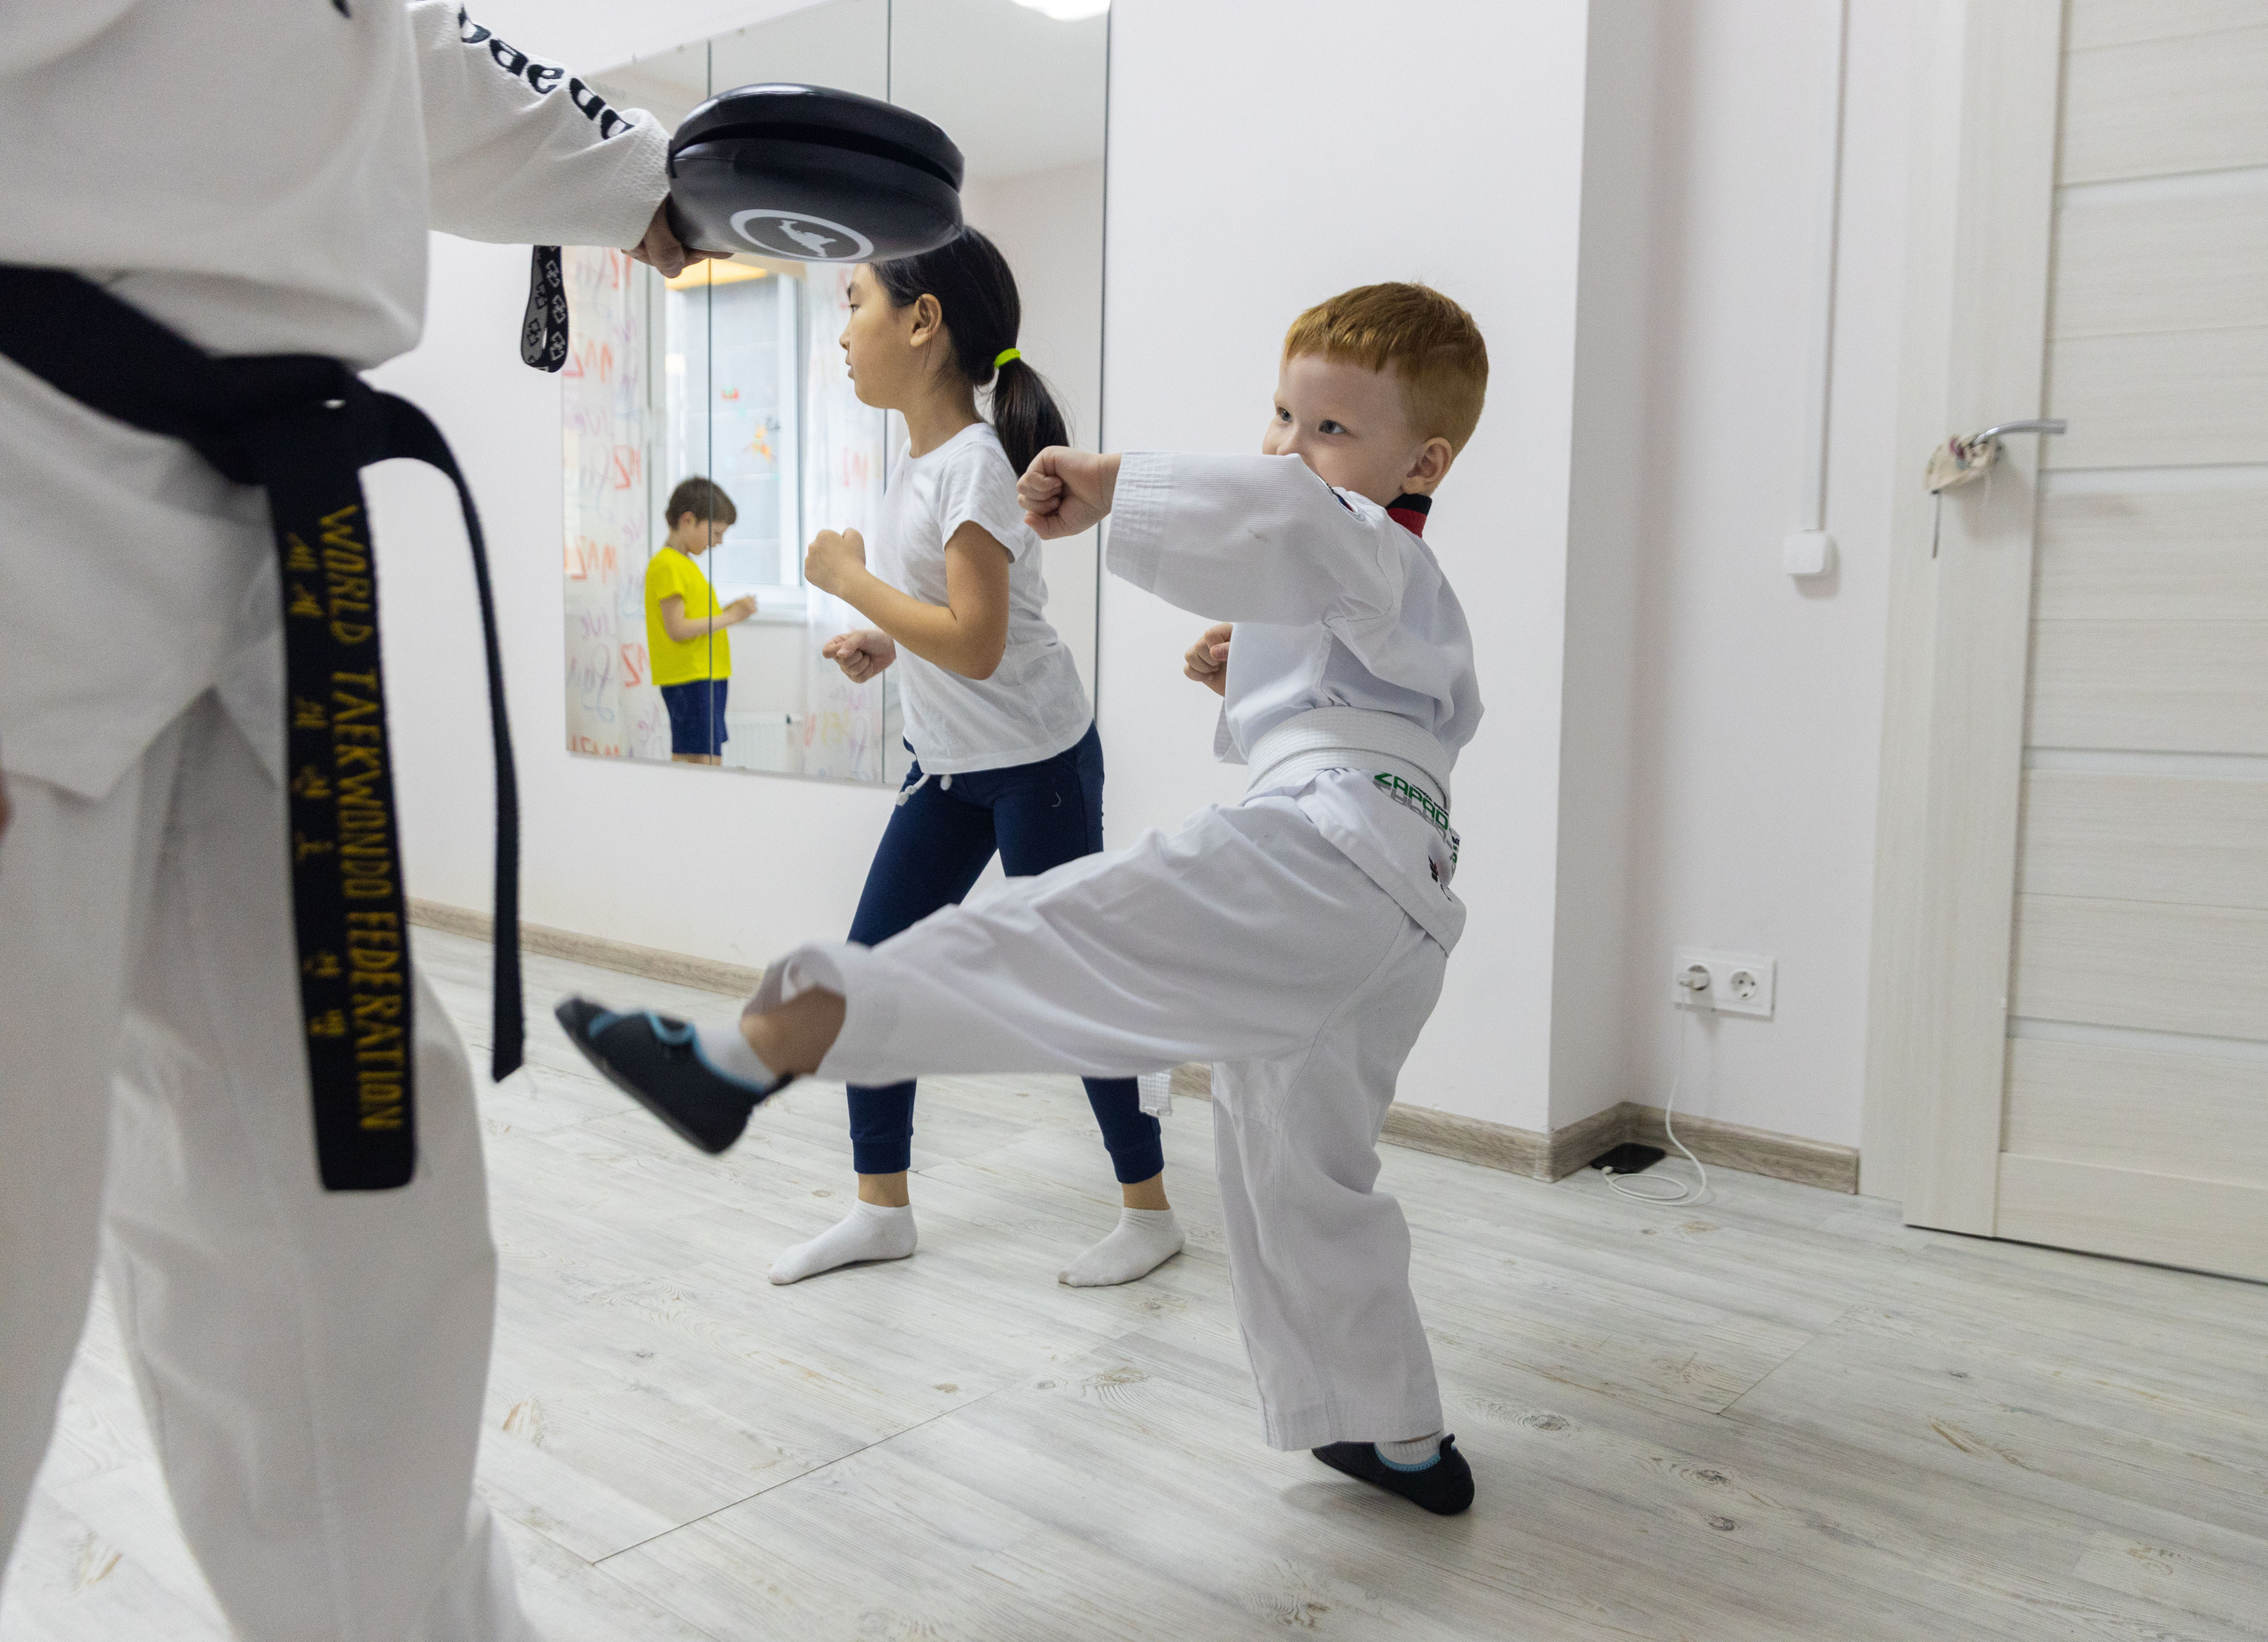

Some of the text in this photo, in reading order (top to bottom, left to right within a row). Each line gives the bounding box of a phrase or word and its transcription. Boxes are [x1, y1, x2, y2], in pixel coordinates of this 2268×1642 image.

[320, 503, 404, 1130] WORLD TAEKWONDO FEDERATION
